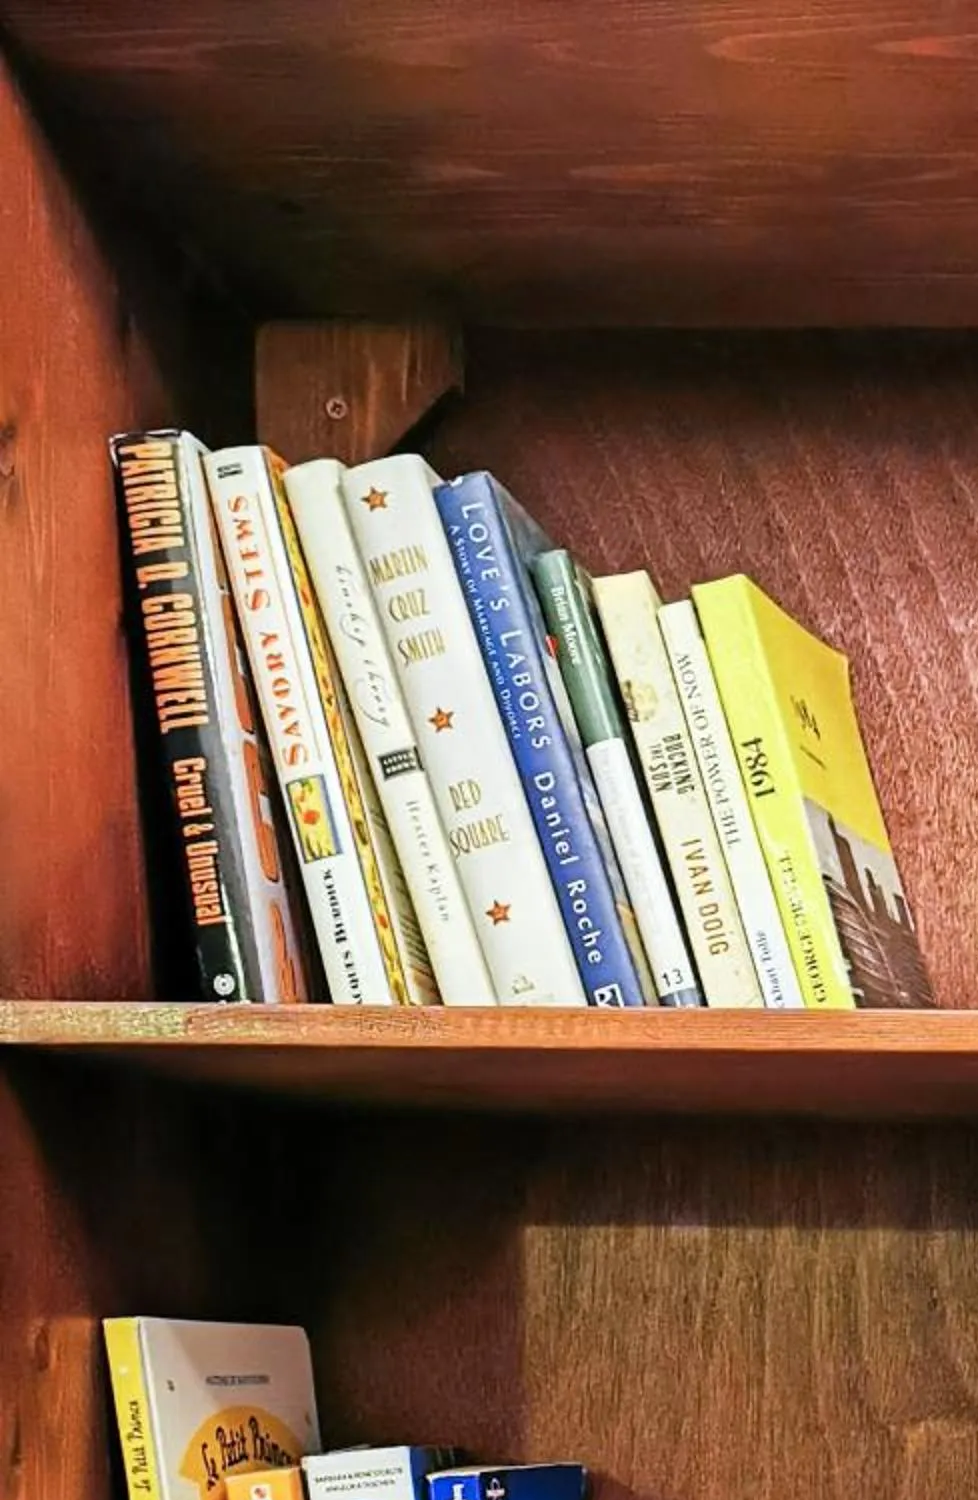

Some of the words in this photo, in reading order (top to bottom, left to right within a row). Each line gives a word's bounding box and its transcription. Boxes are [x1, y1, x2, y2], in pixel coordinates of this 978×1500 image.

[119, 440, 183, 554] PATRICIA
[228, 495, 270, 613] STEWS
[370, 544, 428, 586] MARTIN
[388, 588, 431, 623] CRUZ
[142, 592, 208, 734] CORNWELL
[398, 628, 446, 666] SMITH
[677, 651, 701, 699] NOW
[262, 631, 309, 769] SAVORY
[499, 630, 552, 750] LABORS
[693, 707, 710, 731] OF
[172, 757, 214, 819] Cruel
[448, 781, 481, 809] RED
[648, 760, 672, 793] SUN
[662, 733, 694, 795] BUCKING
[699, 731, 735, 807] POWER
[741, 737, 775, 799] 1984
[448, 812, 511, 857] SQUARE
[720, 808, 742, 849] THE
[186, 839, 228, 925] Unusual
[532, 771, 579, 866] Daniel
[567, 879, 602, 966] Roche
[681, 838, 714, 896] IVAN
[699, 904, 729, 956] DOIG
[661, 968, 685, 988] 13
[216, 1425, 248, 1471] Petit
